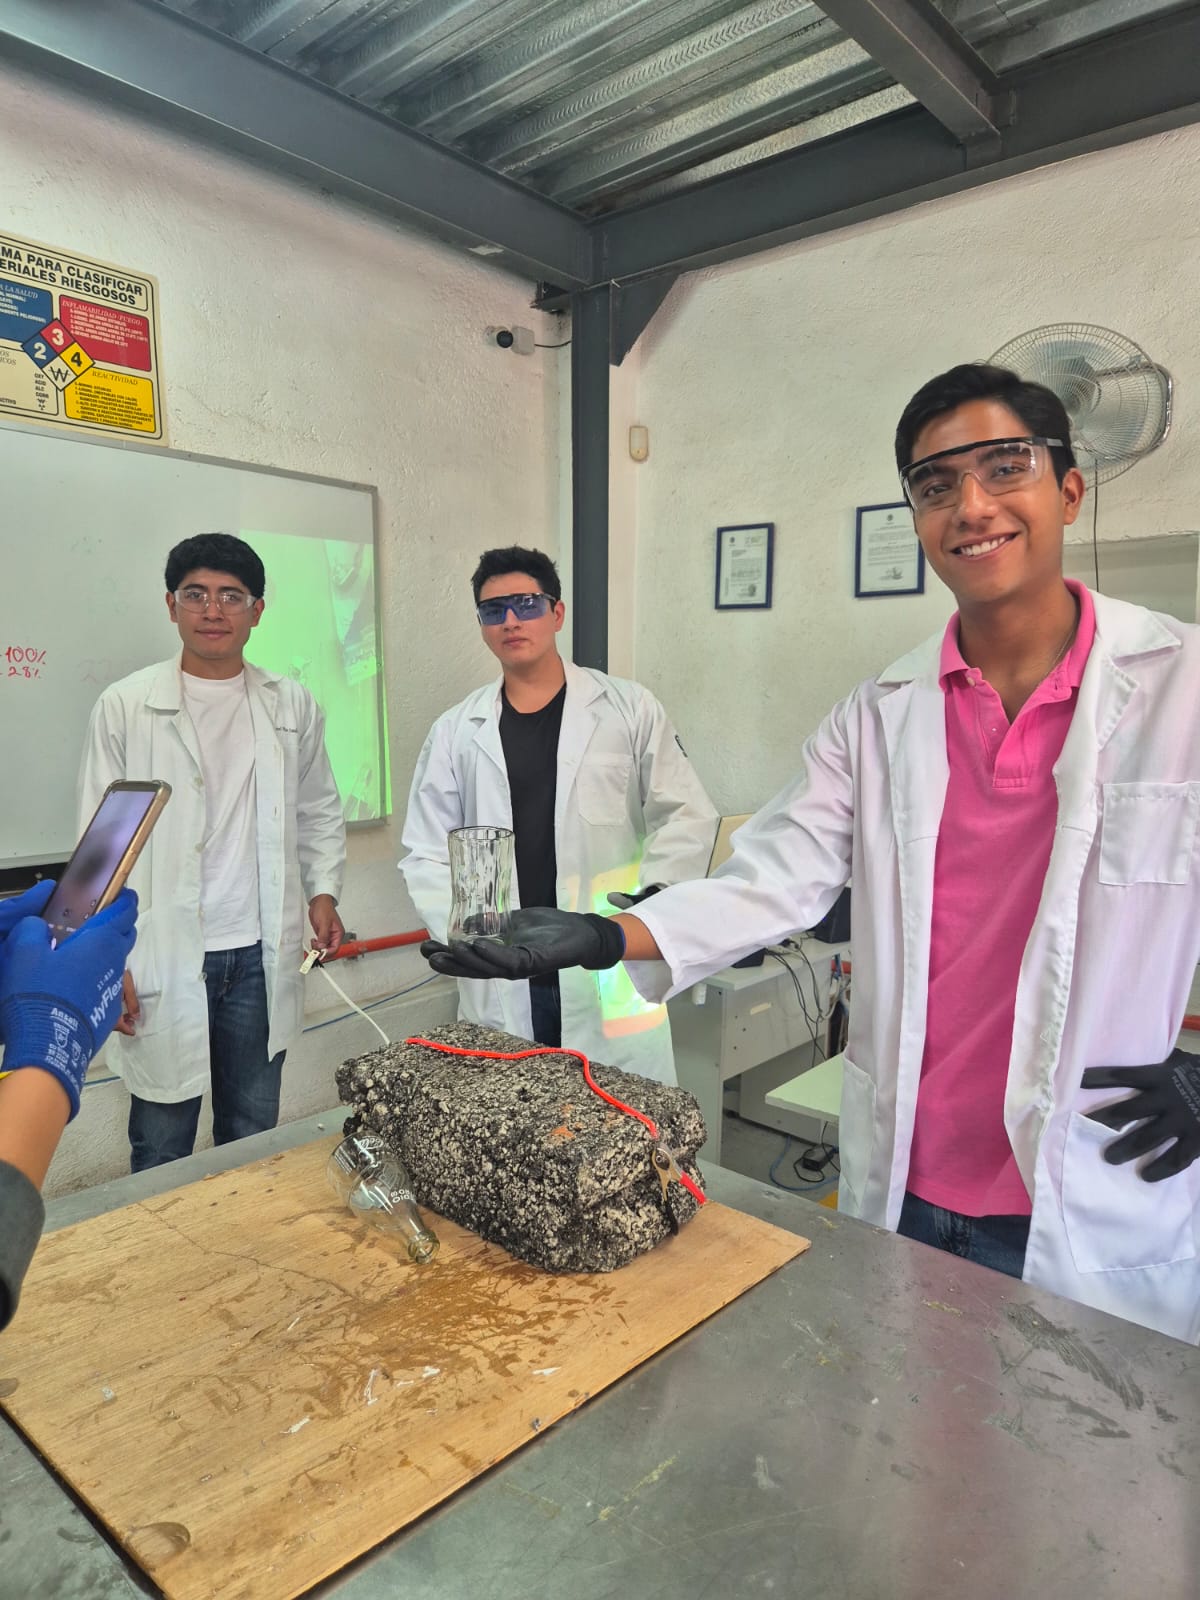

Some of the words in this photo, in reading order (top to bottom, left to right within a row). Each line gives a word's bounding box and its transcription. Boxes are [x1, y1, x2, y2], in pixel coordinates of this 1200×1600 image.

[0, 258, 57, 283] ERIALES
[61, 275, 136, 305] RIESGOSOS
[27, 253, 63, 273] PARA
[66, 265, 142, 296] CLASIFICAR
[52, 328, 65, 346] 3
[34, 342, 47, 360] 2
[70, 351, 83, 367] 4
[92, 370, 138, 386] REACTIVIDAD
